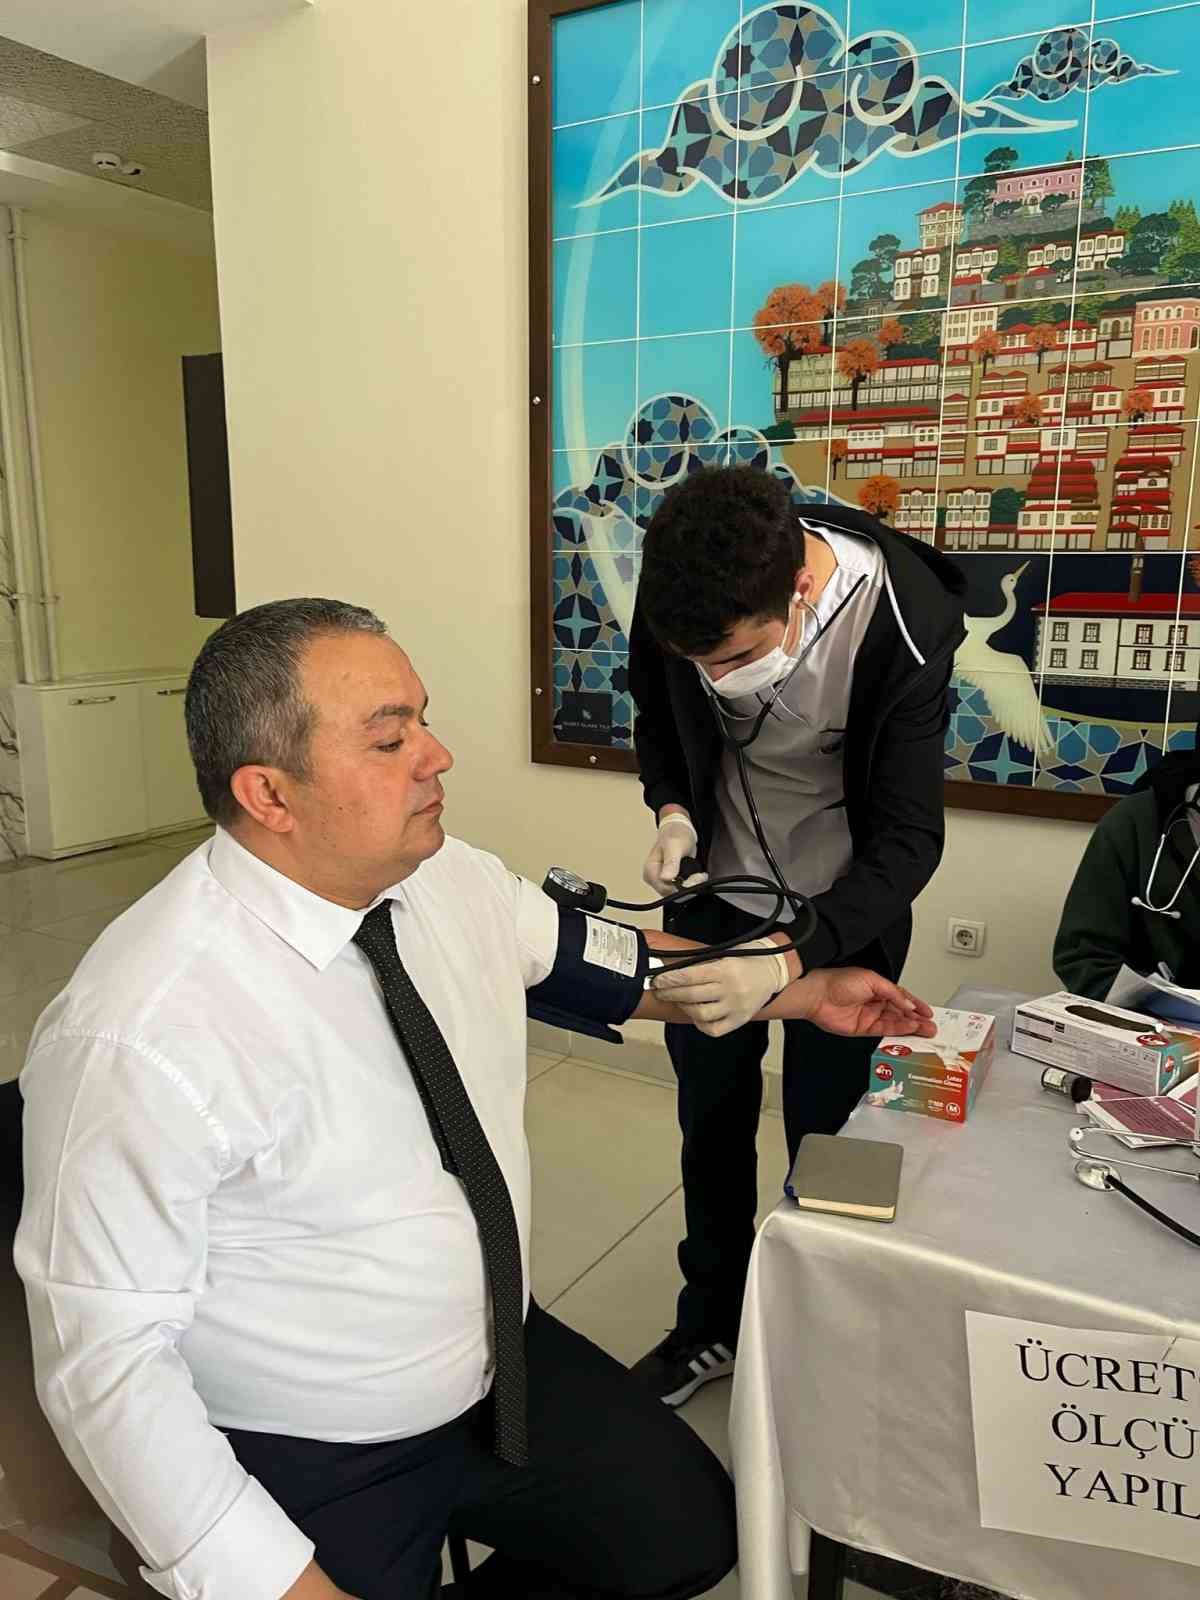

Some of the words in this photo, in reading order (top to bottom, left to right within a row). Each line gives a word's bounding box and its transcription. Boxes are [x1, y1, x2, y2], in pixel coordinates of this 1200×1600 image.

[1014, 1337, 1200, 1402] ÜCRET
[1051, 1402, 1200, 1460] ÖLÇÜ
[1044, 1462, 1200, 1520] YAPIL
